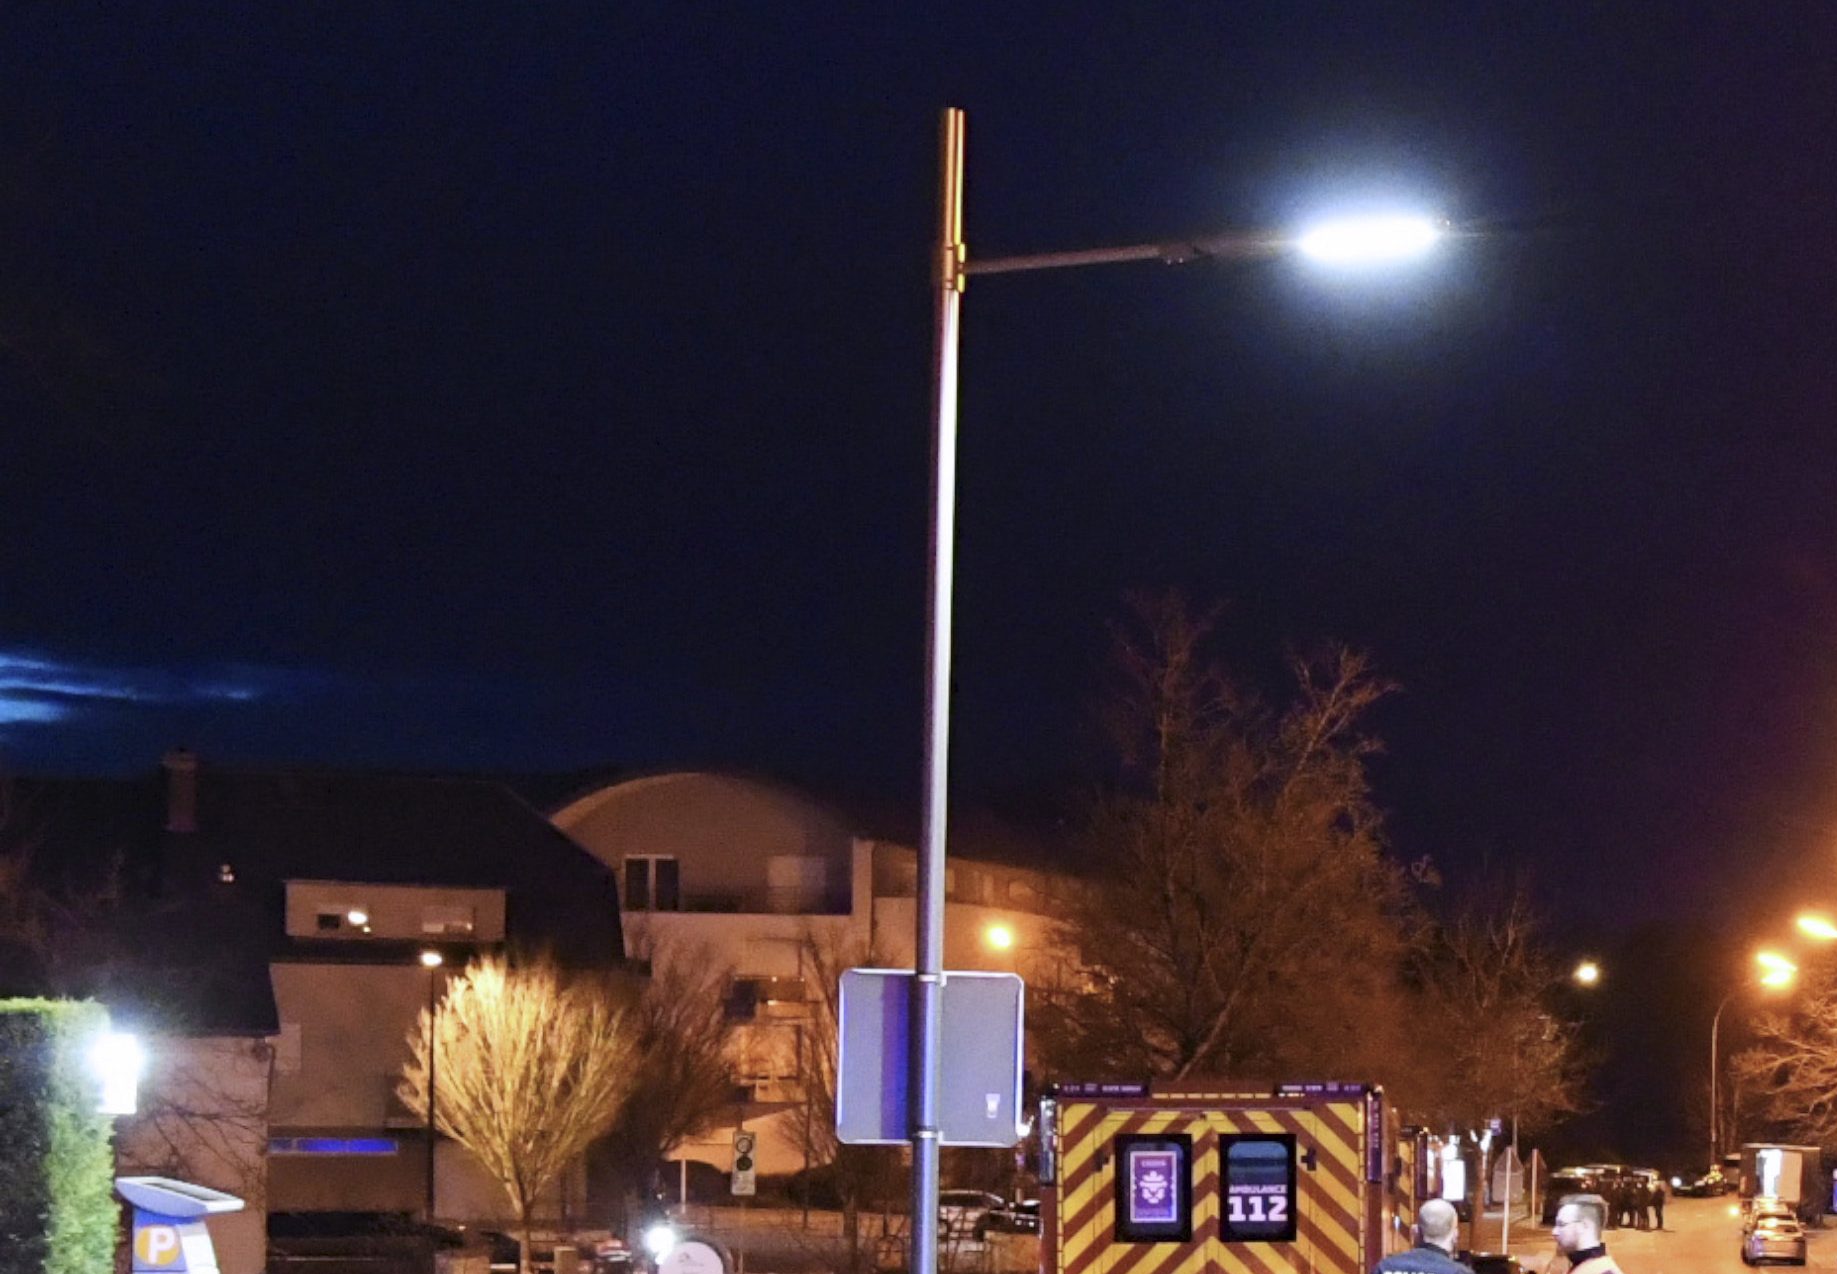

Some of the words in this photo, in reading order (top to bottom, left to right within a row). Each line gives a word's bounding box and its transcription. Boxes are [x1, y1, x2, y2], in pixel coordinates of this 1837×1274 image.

[1229, 1184, 1287, 1194] AMBULANCE
[1228, 1196, 1287, 1221] 112
[147, 1226, 176, 1265] P
